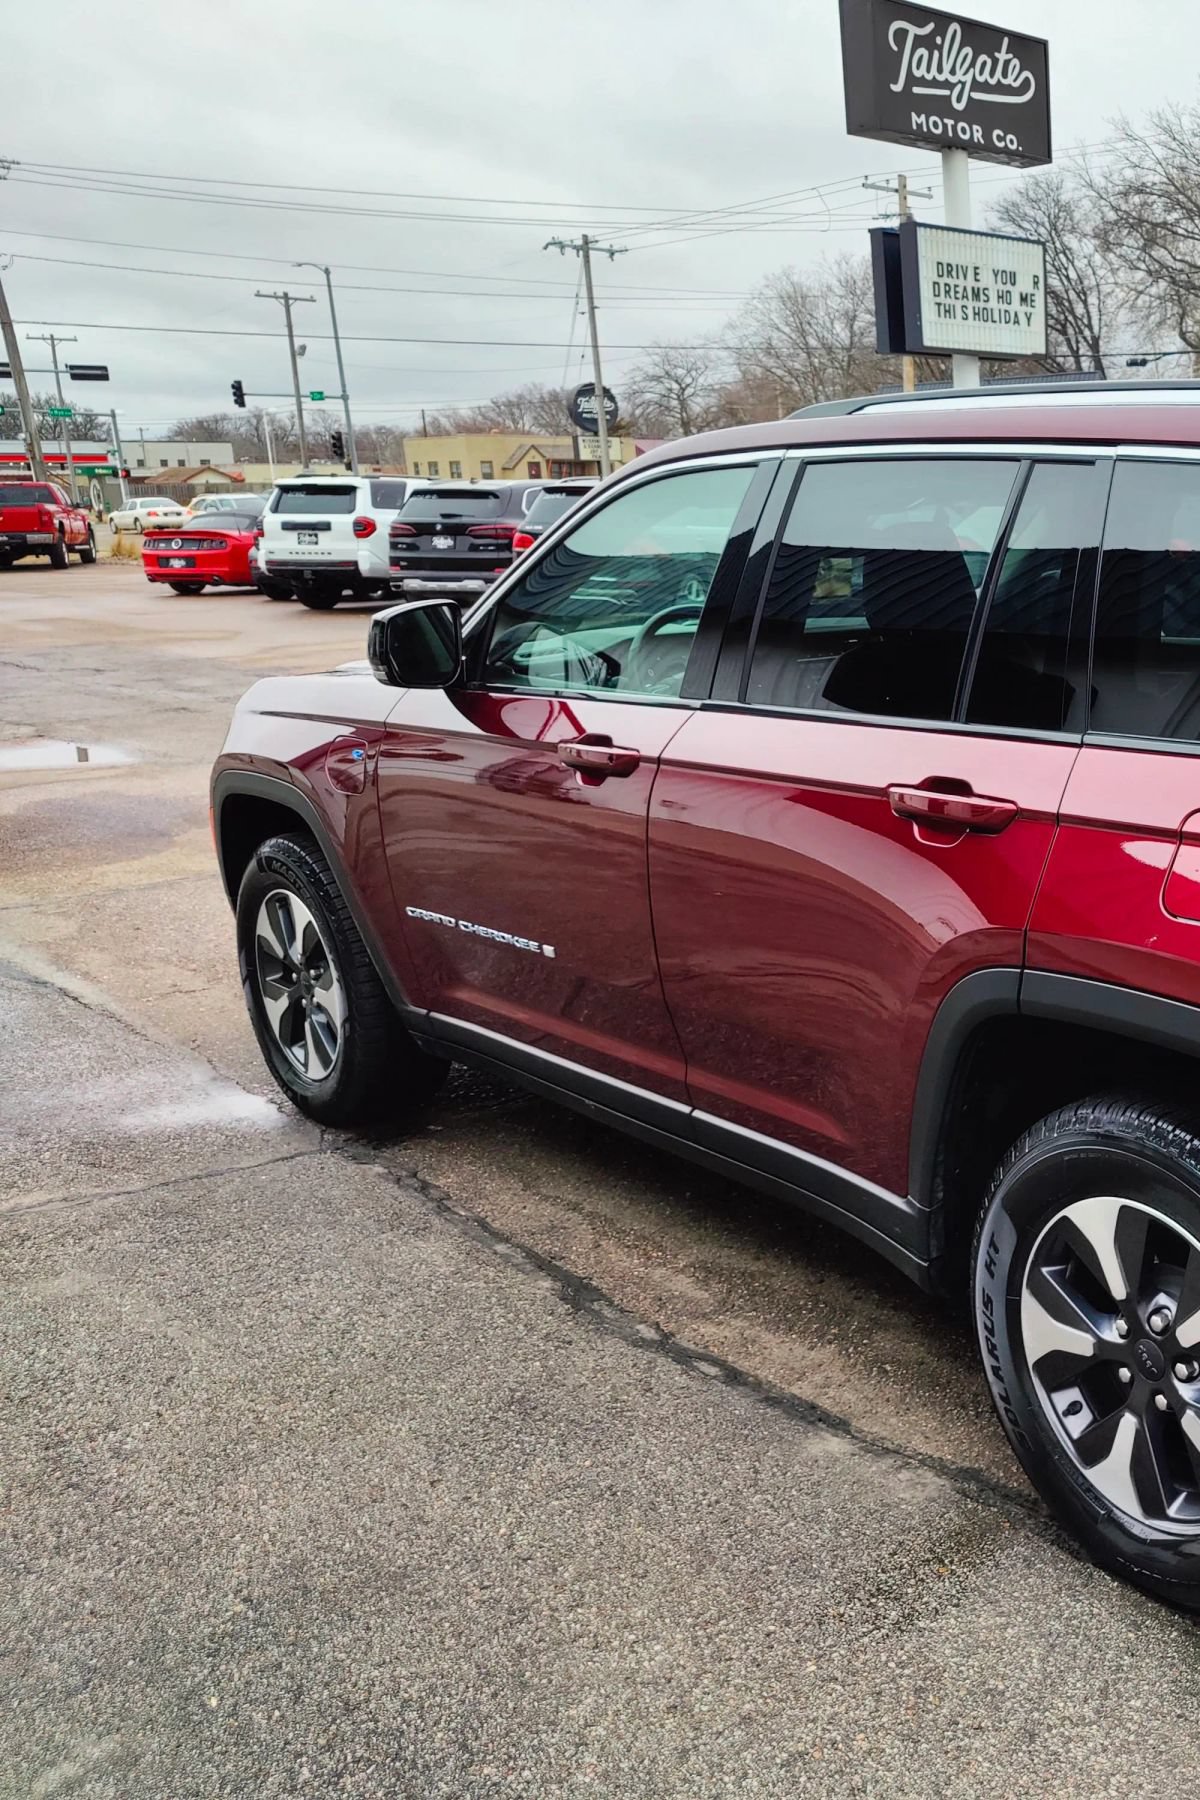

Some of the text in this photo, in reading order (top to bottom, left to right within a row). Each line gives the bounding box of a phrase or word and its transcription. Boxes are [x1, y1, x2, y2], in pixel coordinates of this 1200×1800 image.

[888, 20, 1036, 111] Tailgate
[911, 111, 1023, 151] MOTOR CO.
[936, 261, 980, 282] DRIVE
[933, 281, 990, 303] DREAMS
[935, 302, 1032, 327] THIS HOLIDAY
[406, 906, 541, 953] GRAND CHEROKEE
[982, 1231, 1033, 1451] SOLARUS HT
